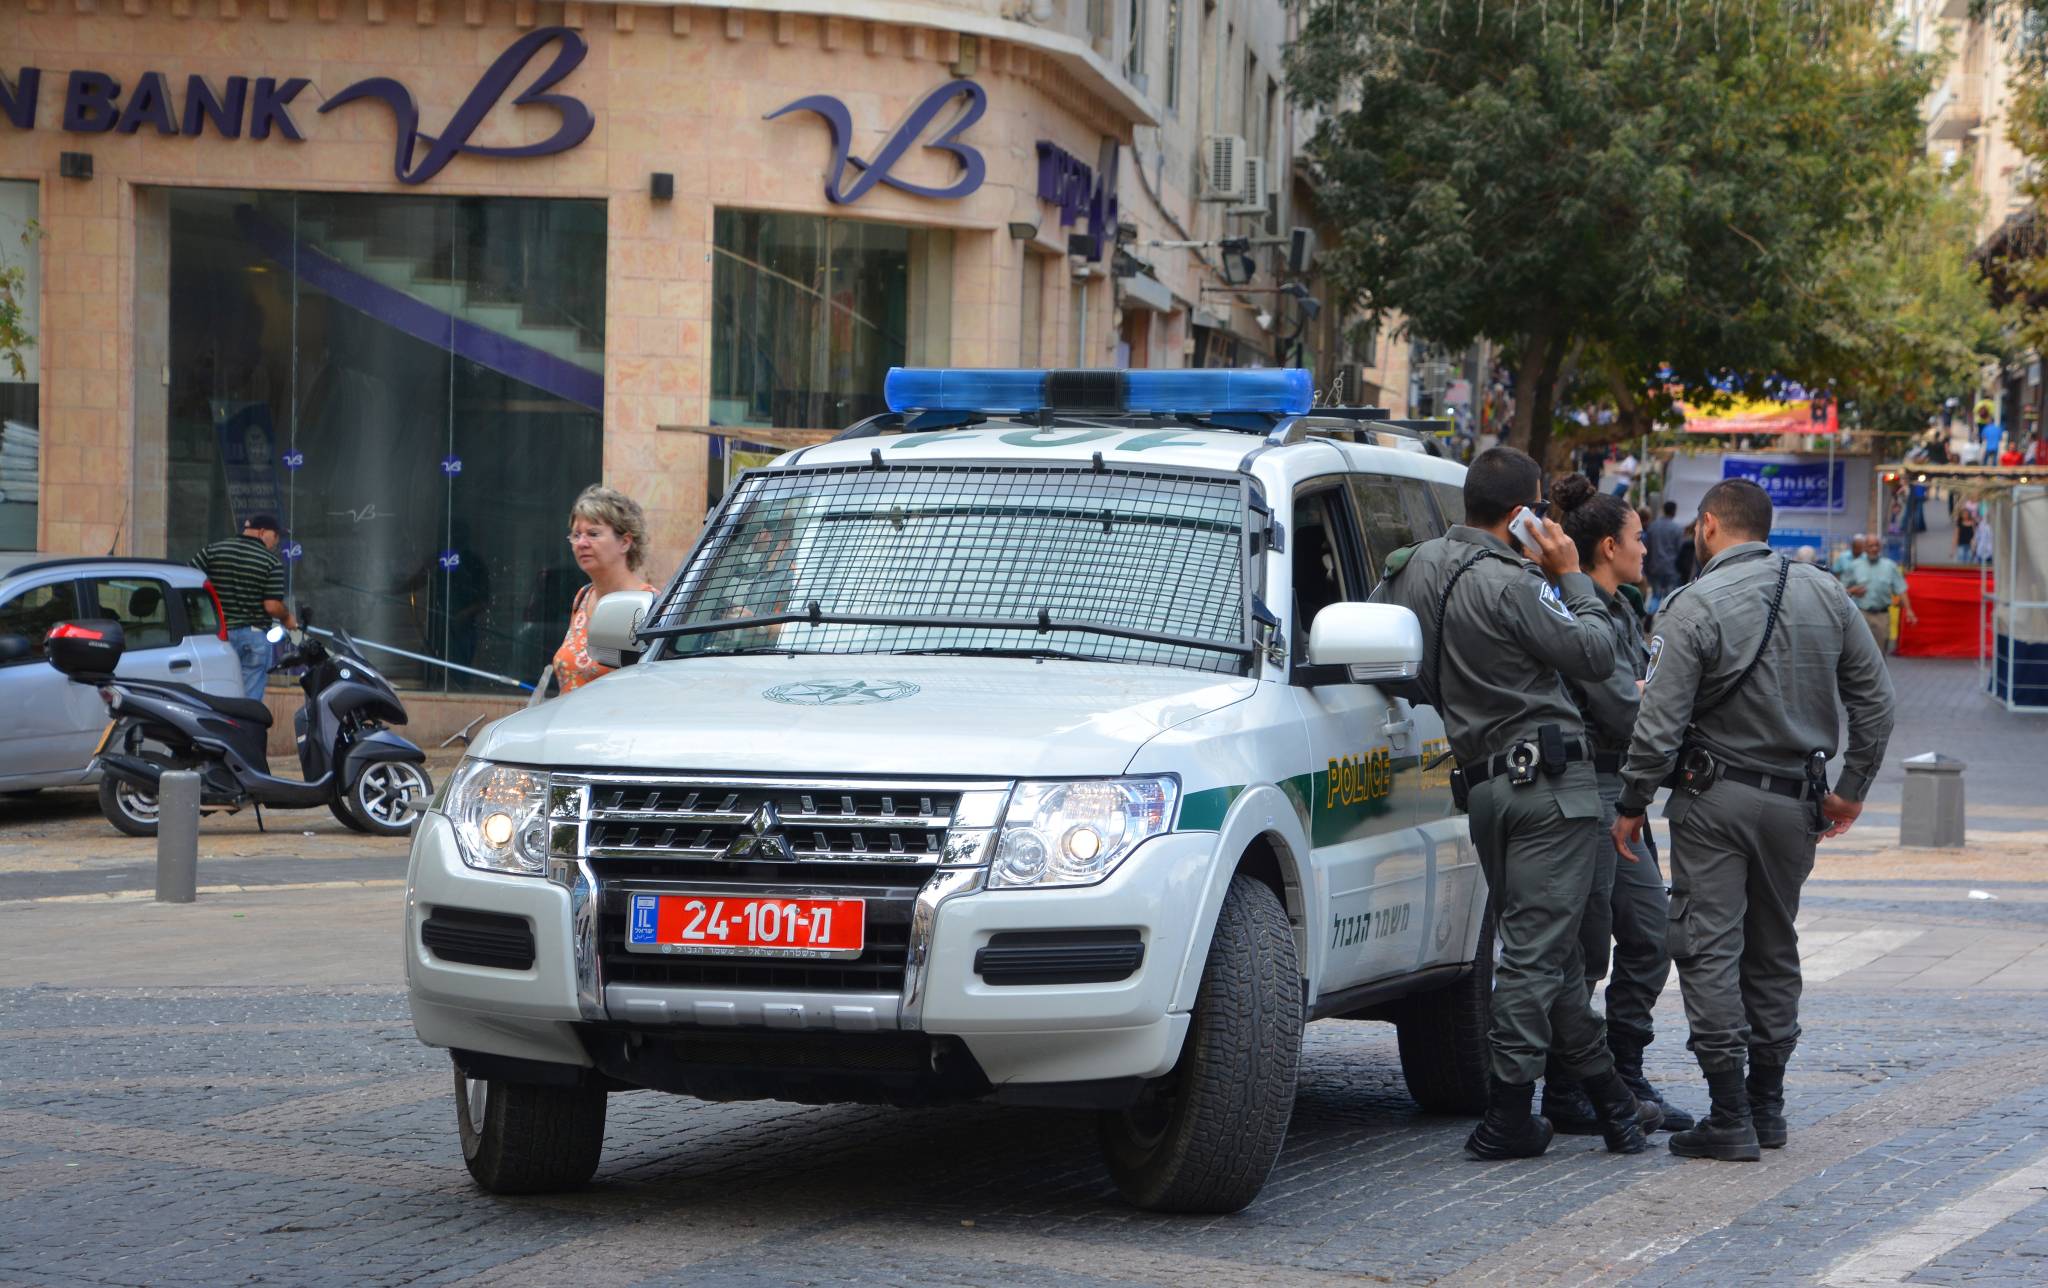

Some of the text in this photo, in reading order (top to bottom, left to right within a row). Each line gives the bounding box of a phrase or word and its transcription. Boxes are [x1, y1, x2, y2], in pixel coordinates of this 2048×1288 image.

[63, 70, 311, 142] BANK
[1327, 745, 1390, 808] POLICE
[638, 909, 651, 928] IL
[1332, 903, 1411, 949] משמר הגבול
